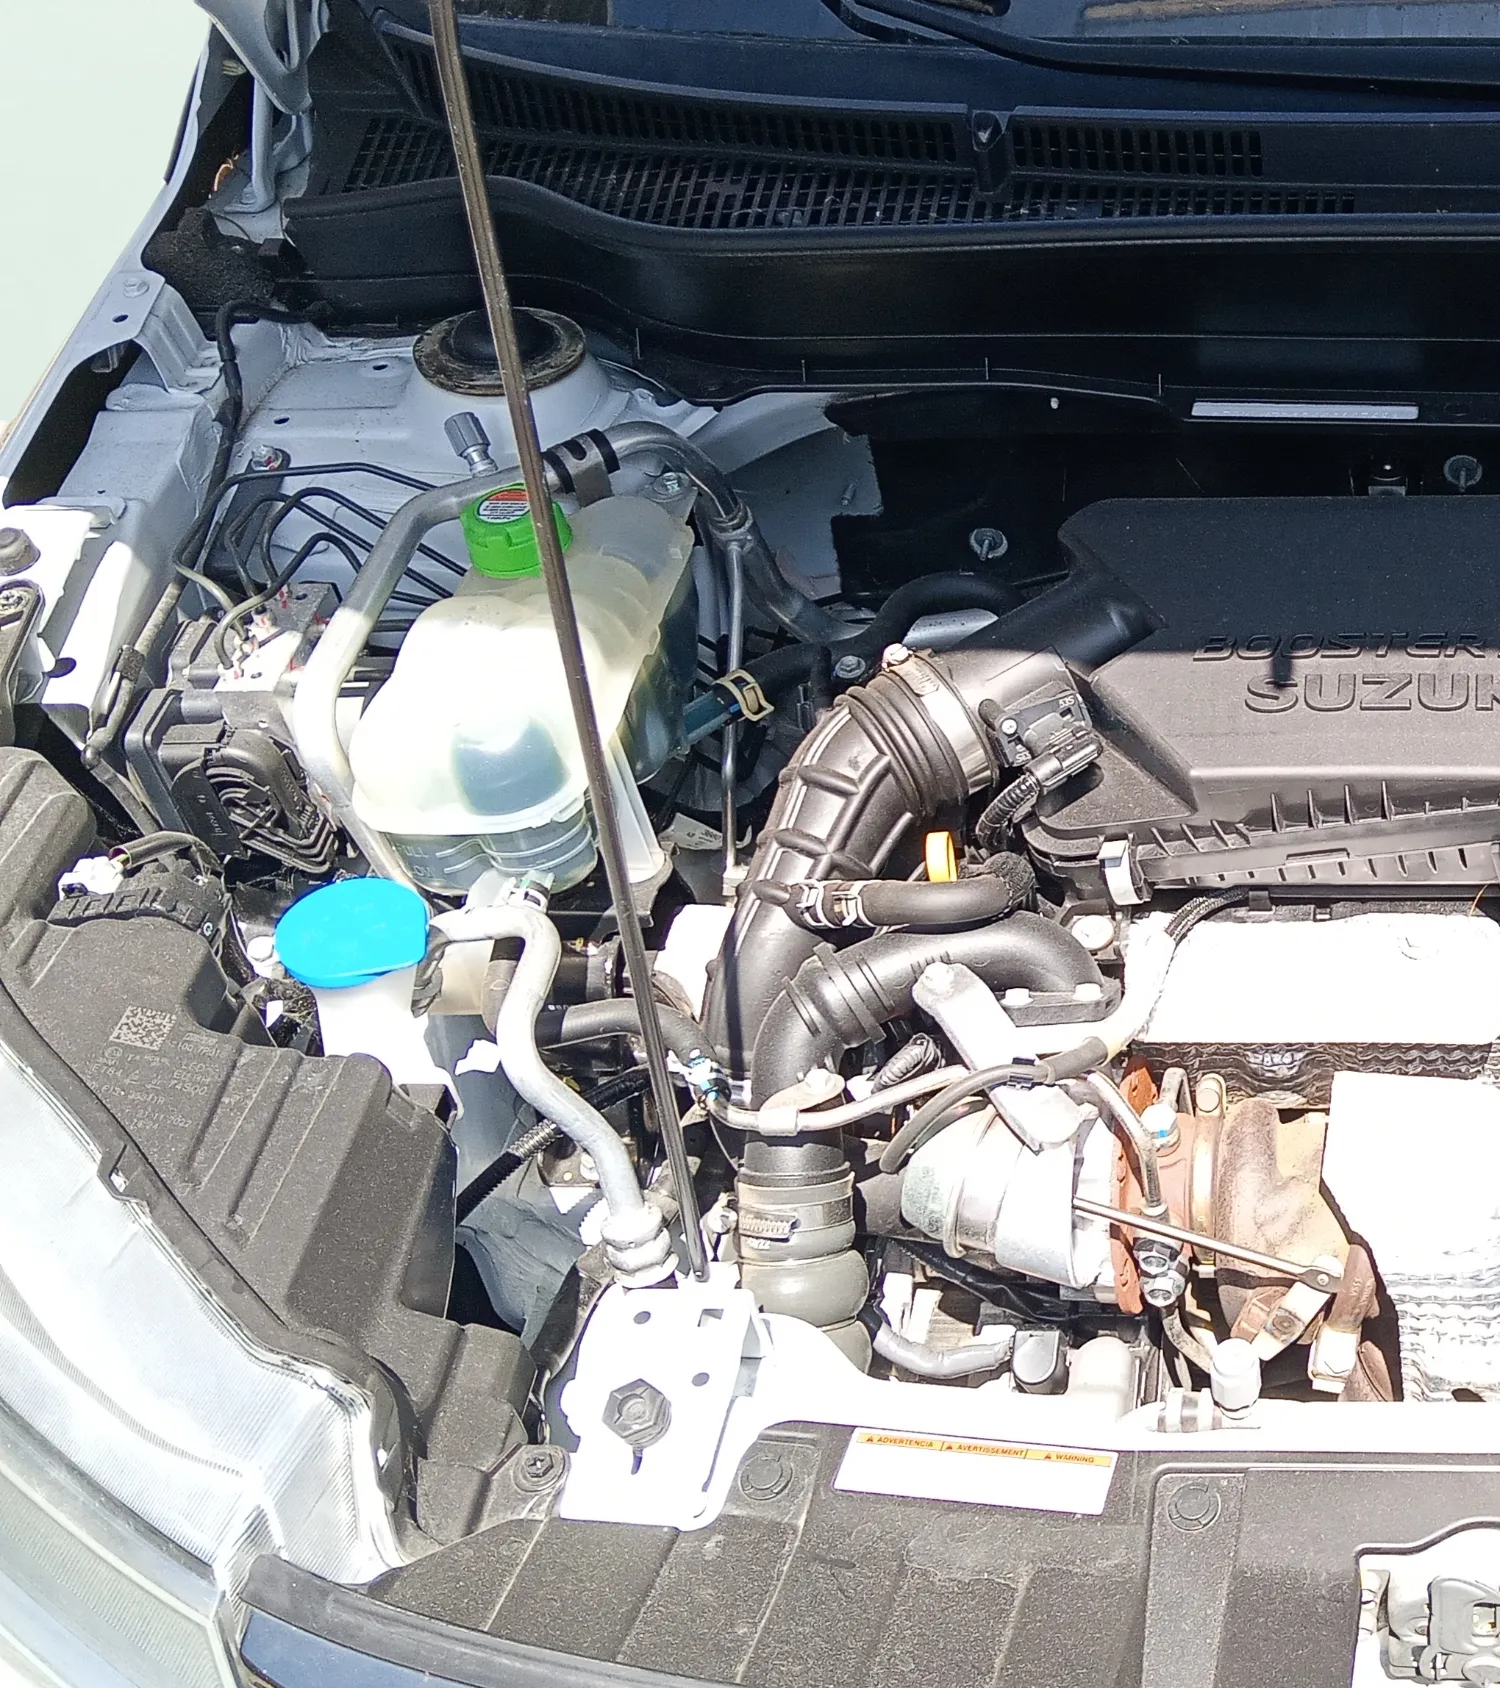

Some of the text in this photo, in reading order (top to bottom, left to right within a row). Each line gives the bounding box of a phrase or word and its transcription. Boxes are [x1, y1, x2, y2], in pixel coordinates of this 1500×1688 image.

[1193, 632, 1486, 662] BOOSTER
[876, 1436, 934, 1448] ADVERTENCIA
[956, 1444, 1024, 1457] AVERTISSEMENT
[1055, 1453, 1095, 1464] WARNING
